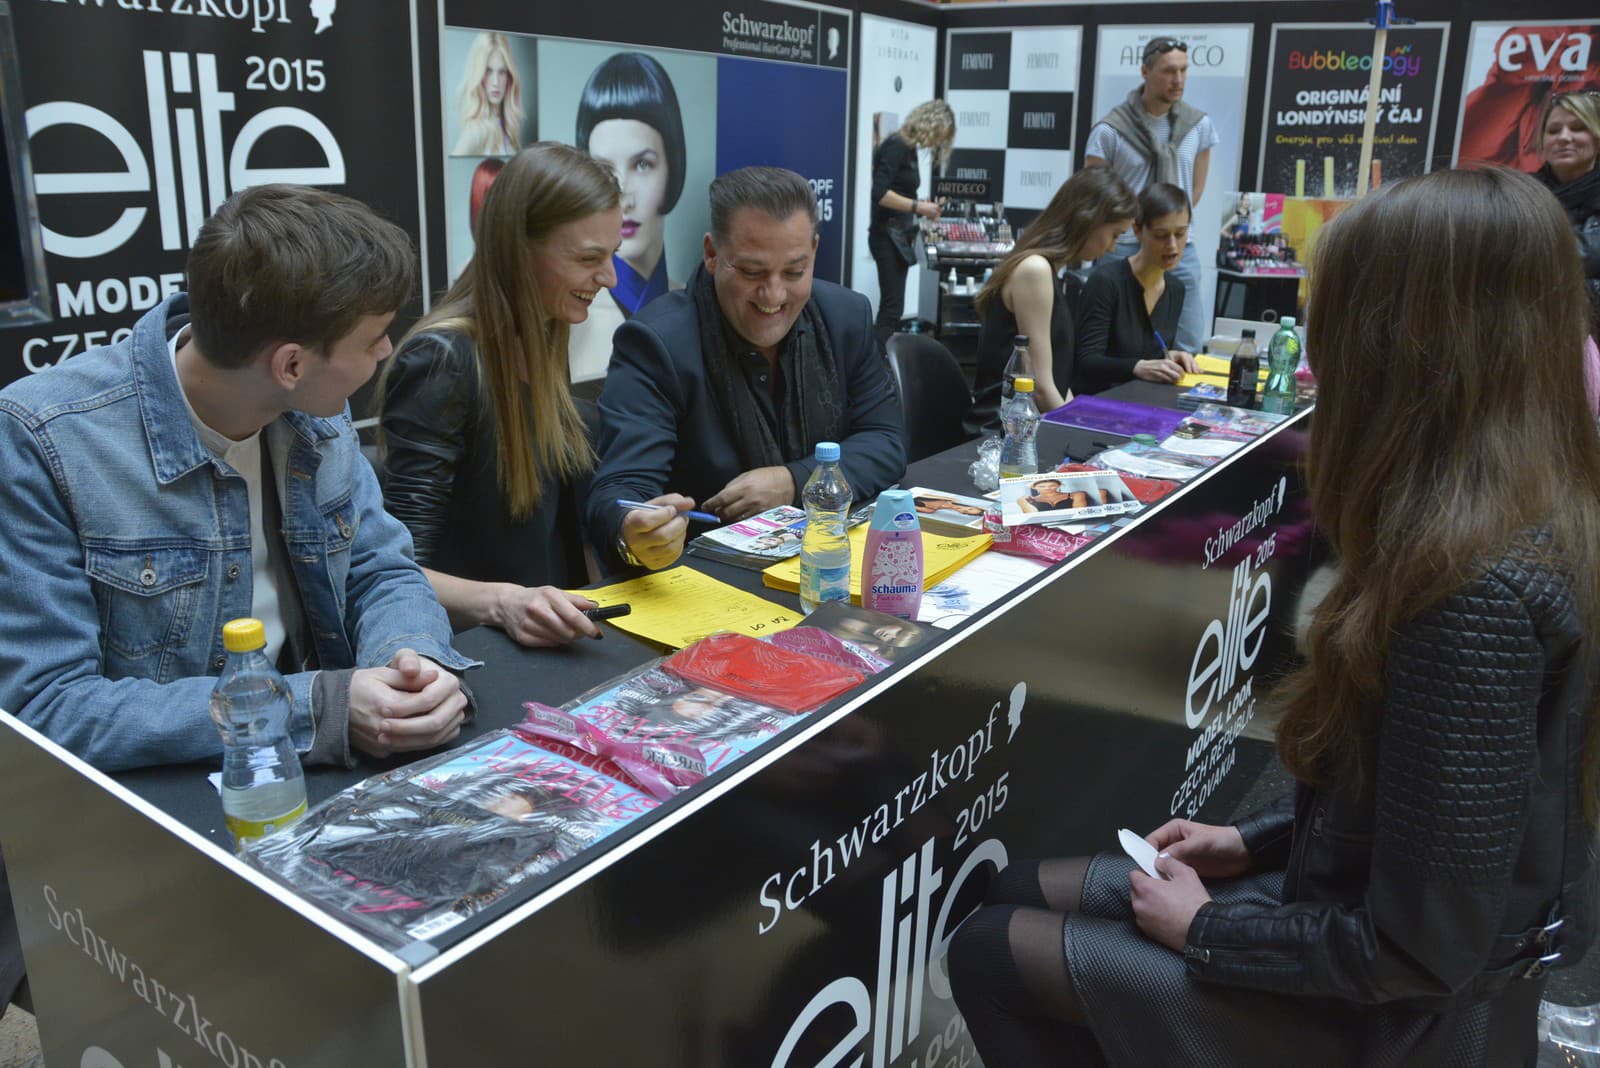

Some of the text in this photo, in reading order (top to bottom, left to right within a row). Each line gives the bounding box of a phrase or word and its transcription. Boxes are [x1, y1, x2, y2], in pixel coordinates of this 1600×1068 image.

[722, 11, 816, 48] Schwarzkopf
[1120, 45, 1225, 66] ARCO
[1287, 50, 1422, 77] Bubbleoogy
[1498, 31, 1593, 72] eva
[245, 55, 327, 93] 2015
[1296, 84, 1402, 105] ORIGINÁNÍ
[1388, 103, 1423, 124] ČAJ
[25, 50, 346, 259] elite
[56, 272, 190, 318] MODE
[1202, 483, 1279, 570] Schwarzkopf
[1254, 532, 1277, 570] 2015
[872, 583, 918, 594] schauma
[1185, 554, 1272, 730] elite
[1185, 675, 1254, 772] MODEL LOOK
[1170, 698, 1257, 816] CZECH REPUBLIC
[1187, 747, 1236, 822] SLOVAKIA
[758, 701, 1001, 935] Schwarzkopf
[952, 771, 1010, 852] 2015
